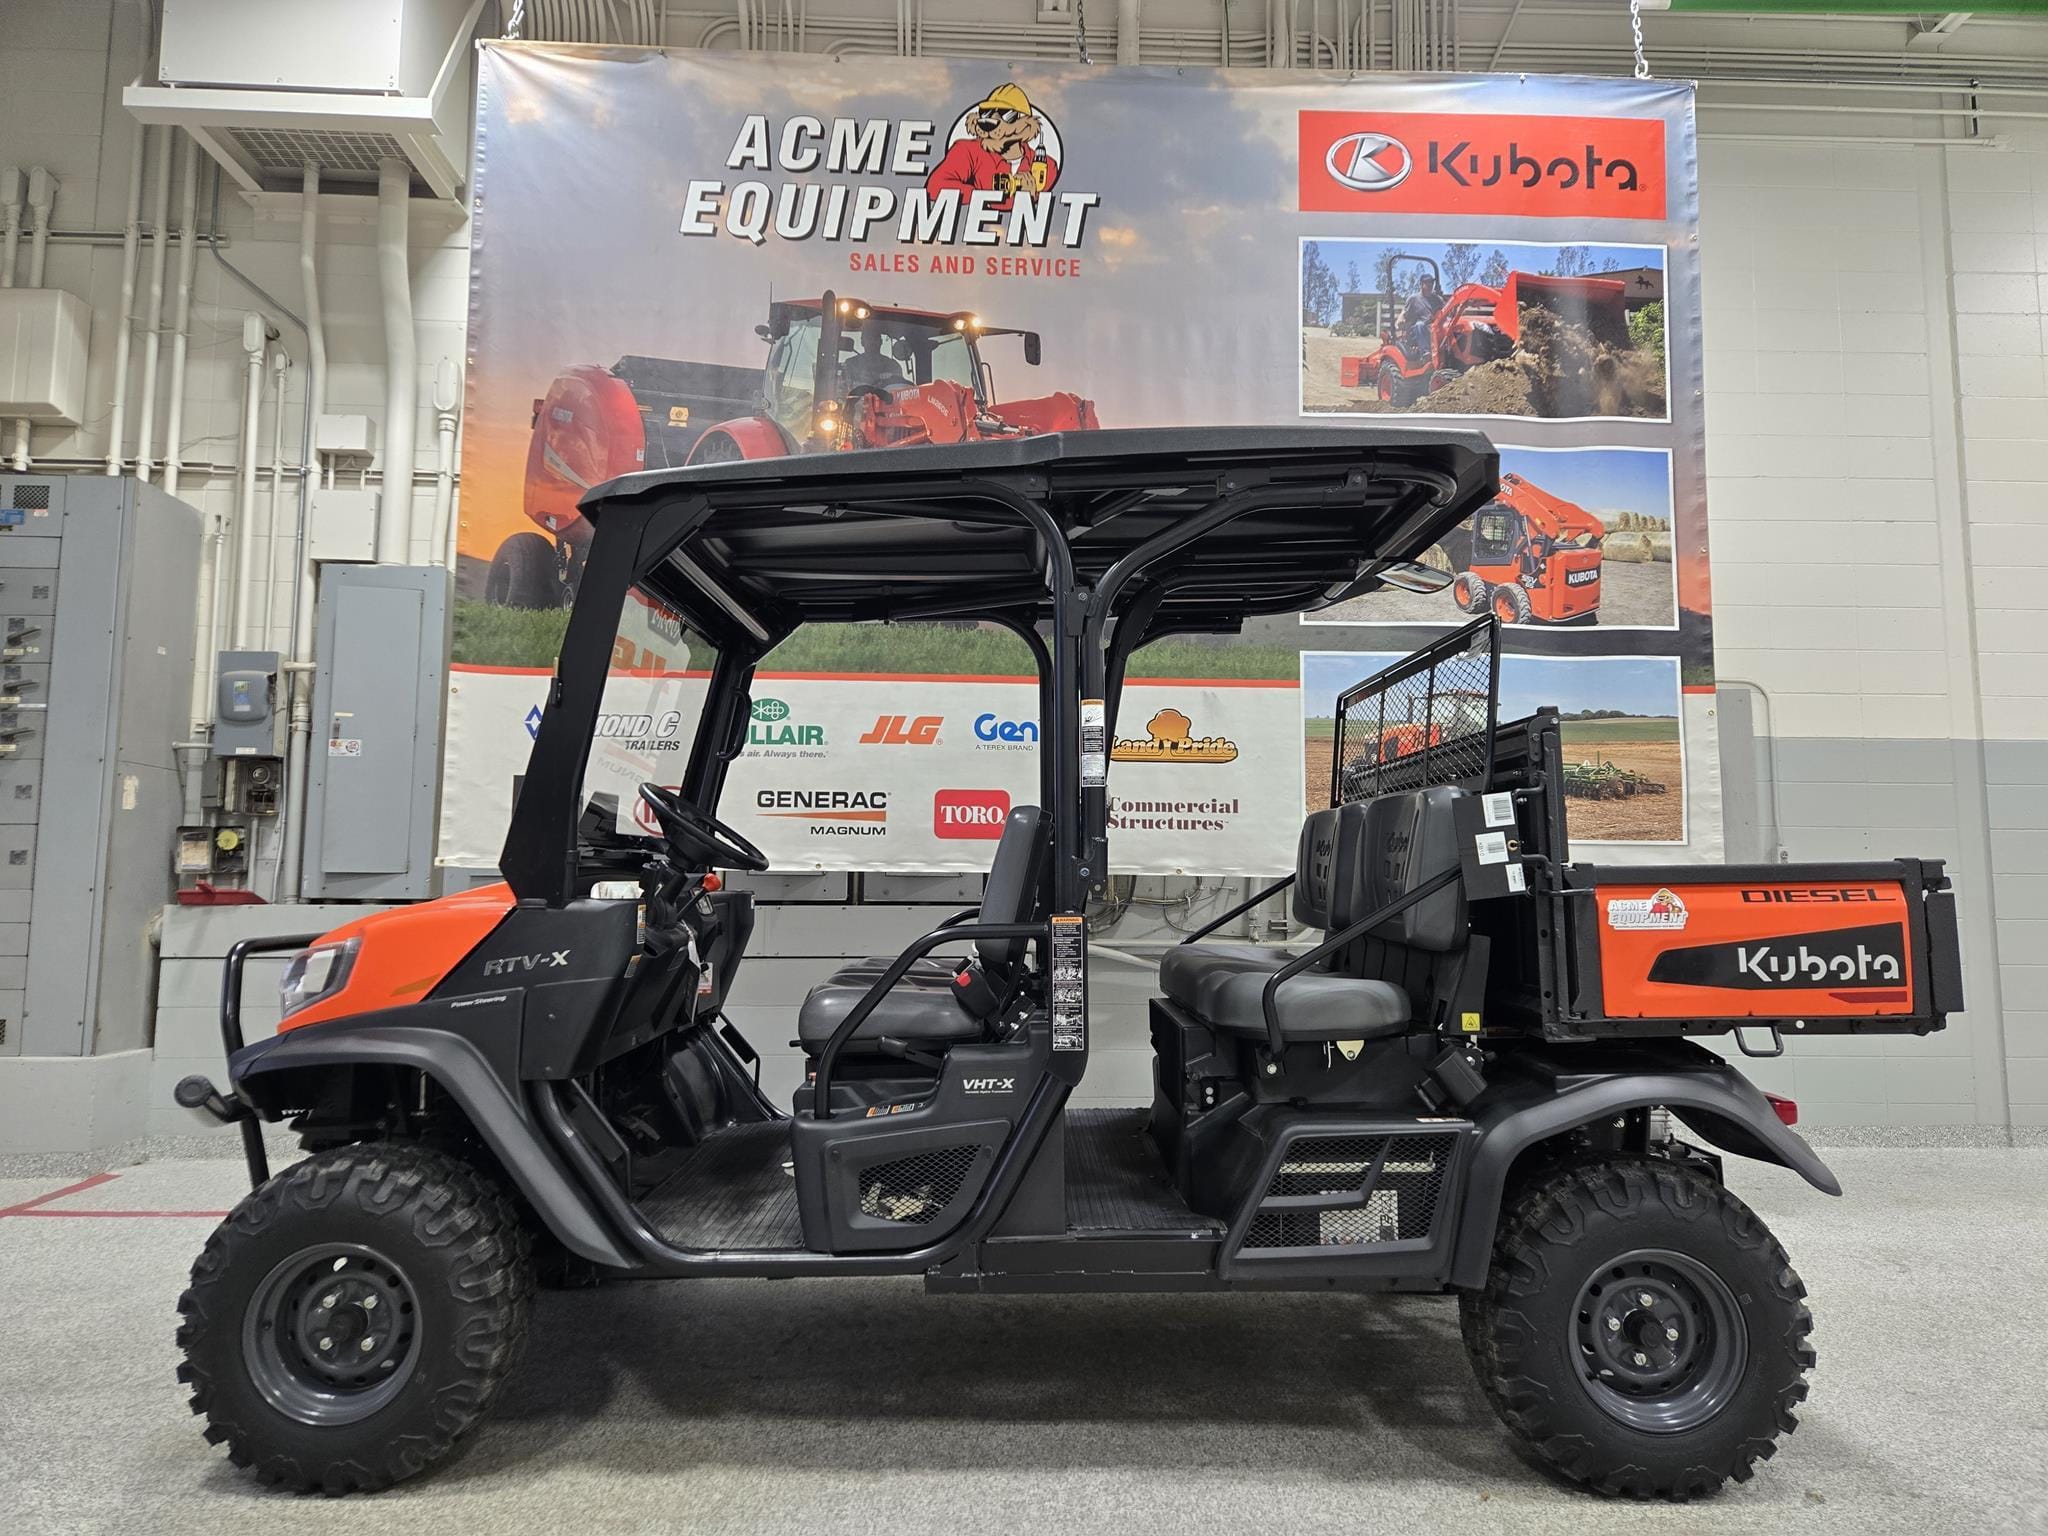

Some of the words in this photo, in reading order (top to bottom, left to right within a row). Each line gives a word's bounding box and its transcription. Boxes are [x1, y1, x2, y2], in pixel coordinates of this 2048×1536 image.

[726, 114, 933, 174] ACME
[1428, 141, 1638, 191] Kubota
[680, 179, 1100, 246] EQUIPMENT
[850, 252, 920, 274] SALES
[930, 255, 975, 275] AND
[986, 256, 1080, 277] SERVICE
[1500, 483, 1513, 496] OTA
[1568, 569, 1598, 585] KUBOTA
[656, 710, 681, 738] C
[859, 715, 944, 745] JLG
[974, 713, 1040, 742] Gen
[745, 725, 824, 746] LLAIR
[625, 740, 680, 751] TRAILERS
[763, 750, 797, 759] Always
[1175, 737, 1236, 755] Pride
[757, 790, 887, 809] GENERAC
[1109, 797, 1239, 814] Commercial
[810, 827, 886, 836] MAGNUM
[1107, 814, 1224, 831] Structures
[1741, 888, 1896, 903] DIESEL
[1609, 901, 1648, 912] ACME
[1610, 912, 1687, 925] EQUIPMENT
[483, 950, 571, 976] RTV-X
[1737, 945, 1899, 982] Kubota
[963, 1078, 1015, 1090] VHT-X
